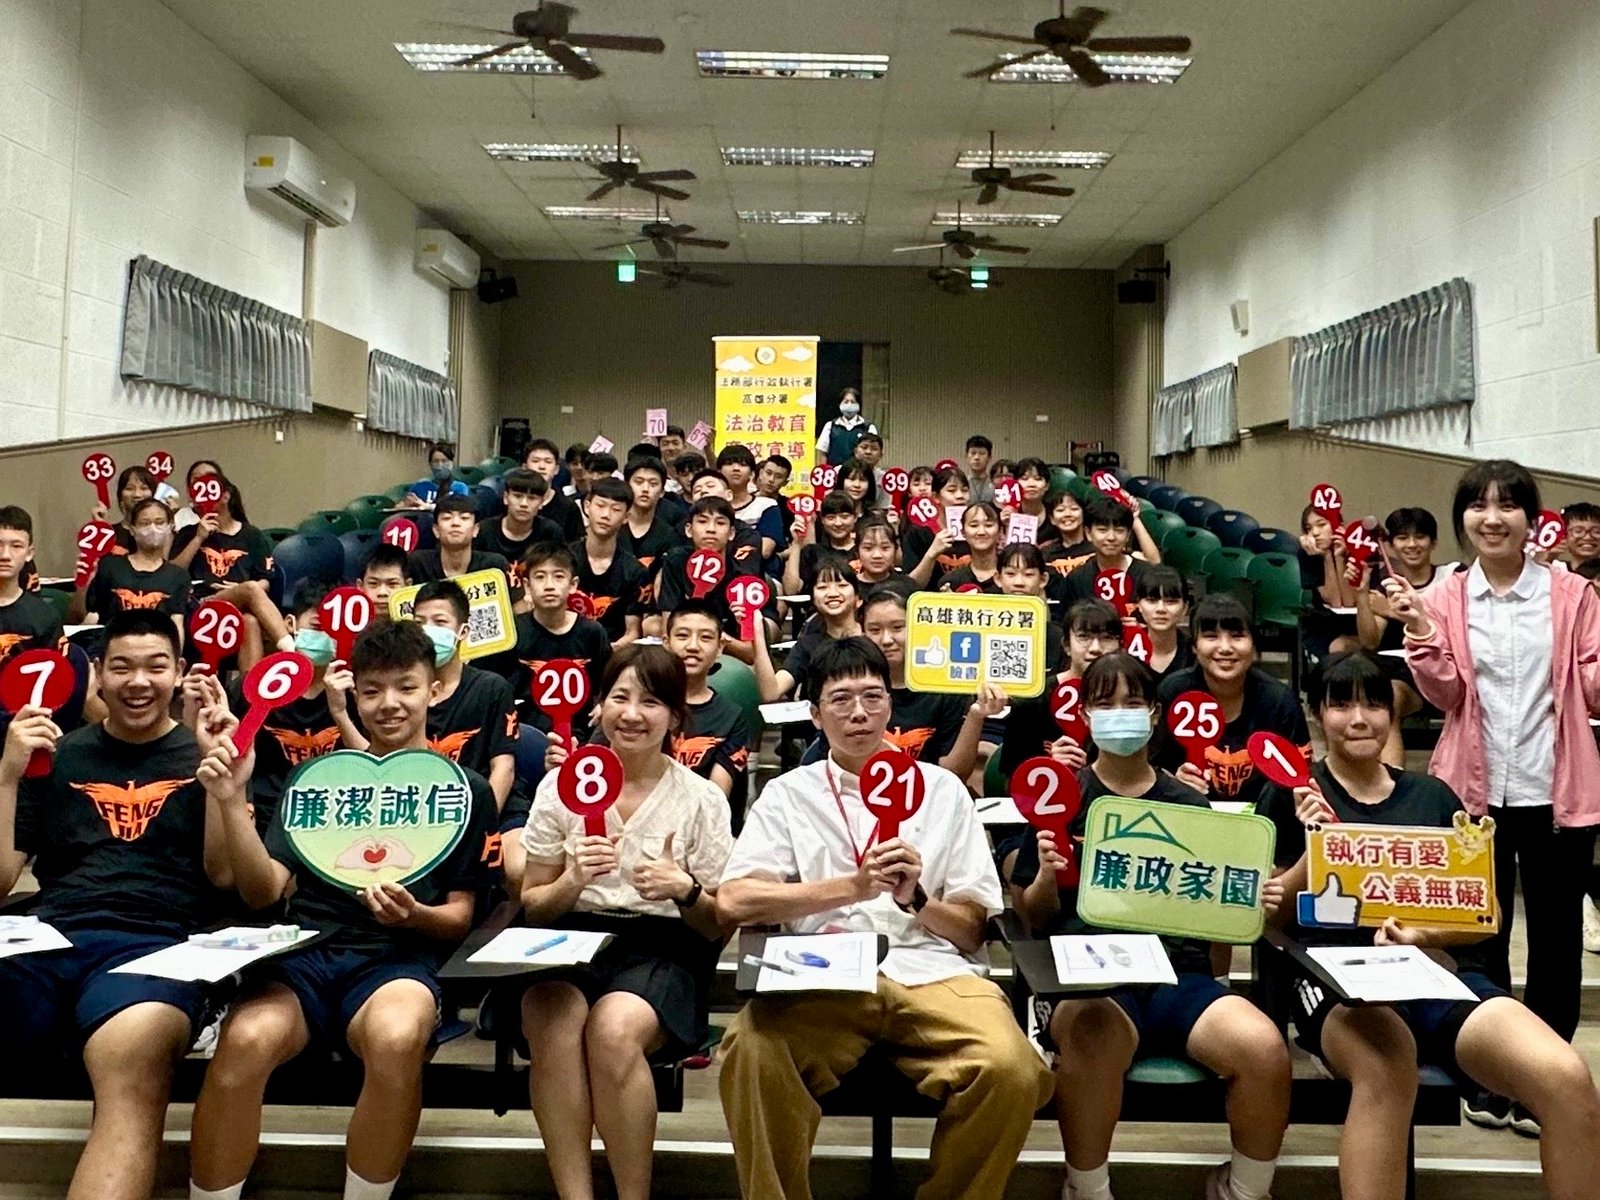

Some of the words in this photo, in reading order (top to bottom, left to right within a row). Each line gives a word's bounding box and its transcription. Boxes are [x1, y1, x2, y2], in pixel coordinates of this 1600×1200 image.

[650, 419, 665, 434] 70
[726, 414, 806, 432] 法治教育
[726, 441, 805, 459] 政宣導
[85, 457, 114, 480] 33
[148, 456, 173, 475] 34
[811, 466, 836, 488] 38
[193, 480, 221, 503] 29
[885, 472, 909, 492] 39
[1096, 472, 1121, 492] 40
[788, 496, 815, 513] 19
[910, 498, 938, 523] 18
[1313, 487, 1341, 511] 42
[78, 524, 115, 552] 27
[386, 525, 412, 552] 11
[690, 554, 721, 584] 12
[730, 581, 765, 606] 16
[1097, 568, 1127, 601] 37
[323, 590, 370, 633] 10
[917, 607, 1033, 628] 高雄執行分署
[193, 607, 240, 649] 26
[19, 660, 56, 708] 7
[257, 660, 300, 700] 6
[538, 667, 585, 706] 20
[950, 666, 977, 680] 臉書
[1173, 700, 1220, 739] 25
[1262, 739, 1298, 778] 1
[574, 755, 608, 804] 8
[867, 760, 918, 811] 21
[1027, 766, 1066, 816] 2
[97, 797, 164, 824] FENG
[286, 783, 467, 830] 廉潔誠信
[1325, 833, 1447, 868] 執行有愛
[1090, 848, 1261, 908] 廉政家園
[1362, 874, 1486, 908] 公義無礙
